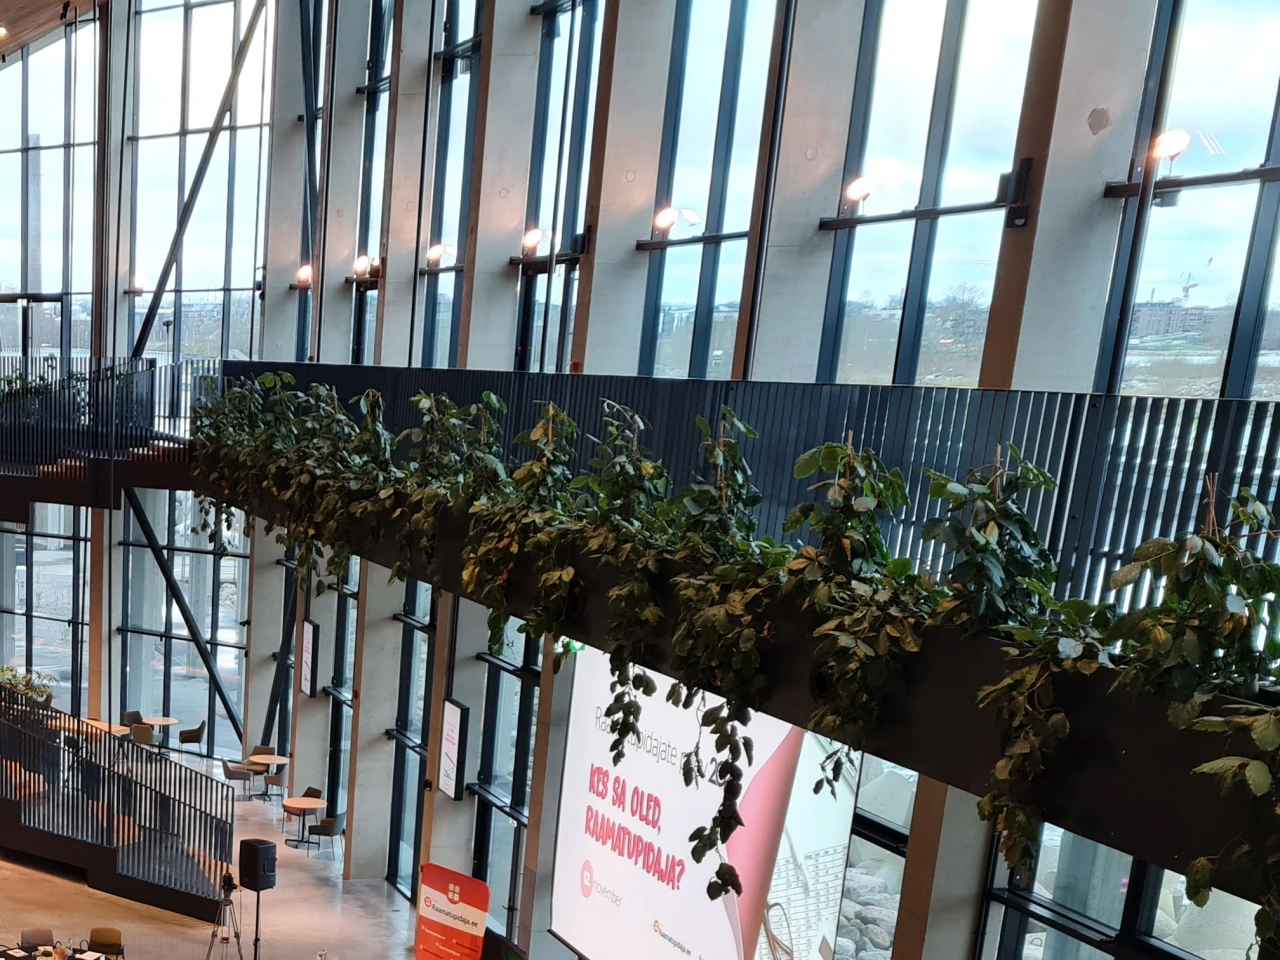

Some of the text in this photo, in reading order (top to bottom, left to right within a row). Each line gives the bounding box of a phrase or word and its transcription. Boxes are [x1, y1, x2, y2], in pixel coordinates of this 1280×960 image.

[589, 763, 661, 836] KES SA OLED,
[585, 804, 686, 891] RAAMATUPIDAJA?
[431, 903, 479, 928] Raamatupidaja.ee
[594, 880, 622, 907] november
